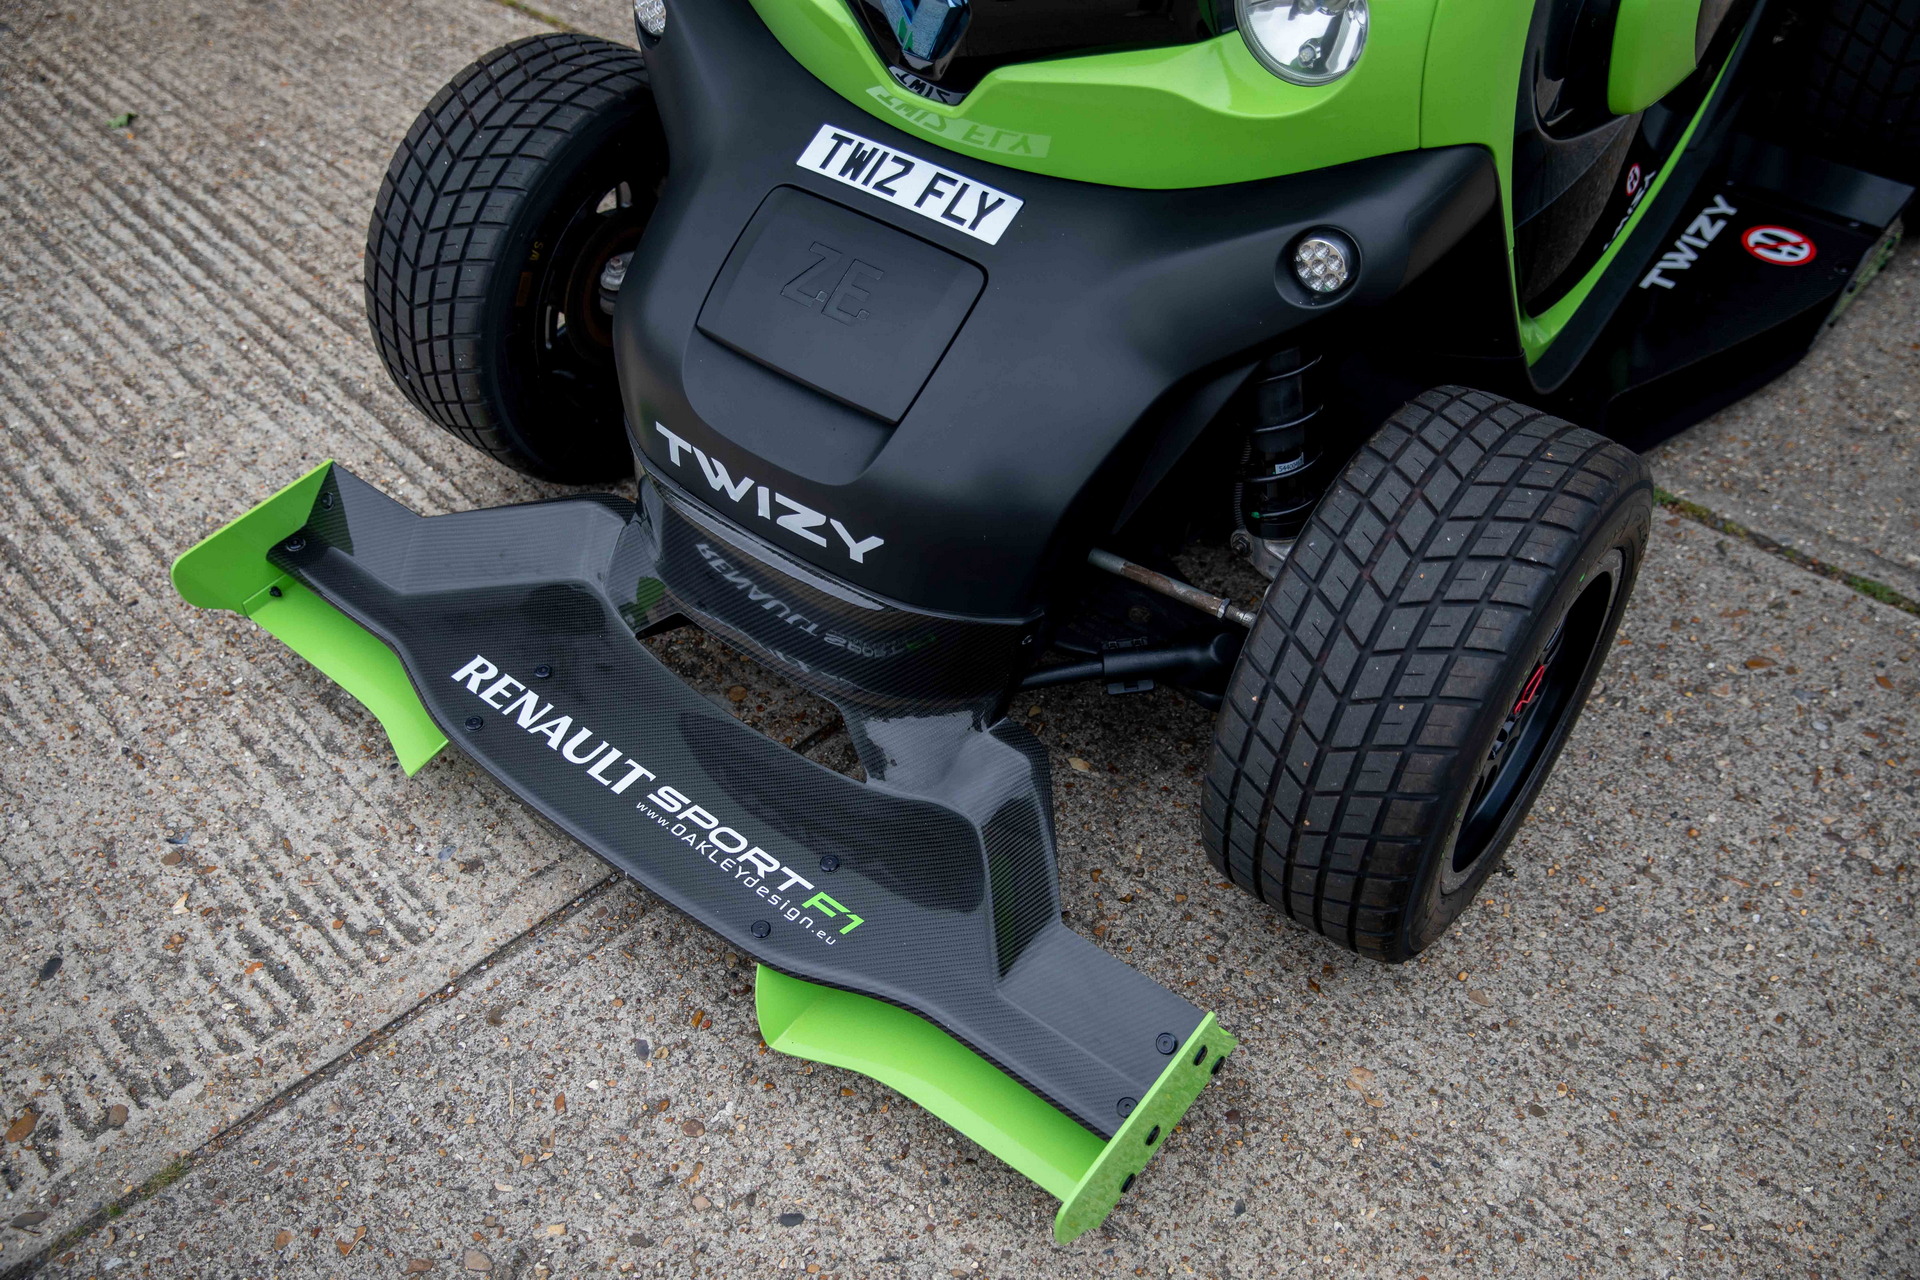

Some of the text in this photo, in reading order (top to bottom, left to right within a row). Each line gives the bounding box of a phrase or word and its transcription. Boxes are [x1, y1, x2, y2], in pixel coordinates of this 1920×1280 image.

[914, 171, 1006, 231] FLY
[1638, 194, 1738, 289] TWIZY
[655, 420, 885, 564] TWIZY
[451, 654, 866, 935] RENAULT SPORT F1
[636, 801, 836, 945] www.OAKLEYdesign.eu
